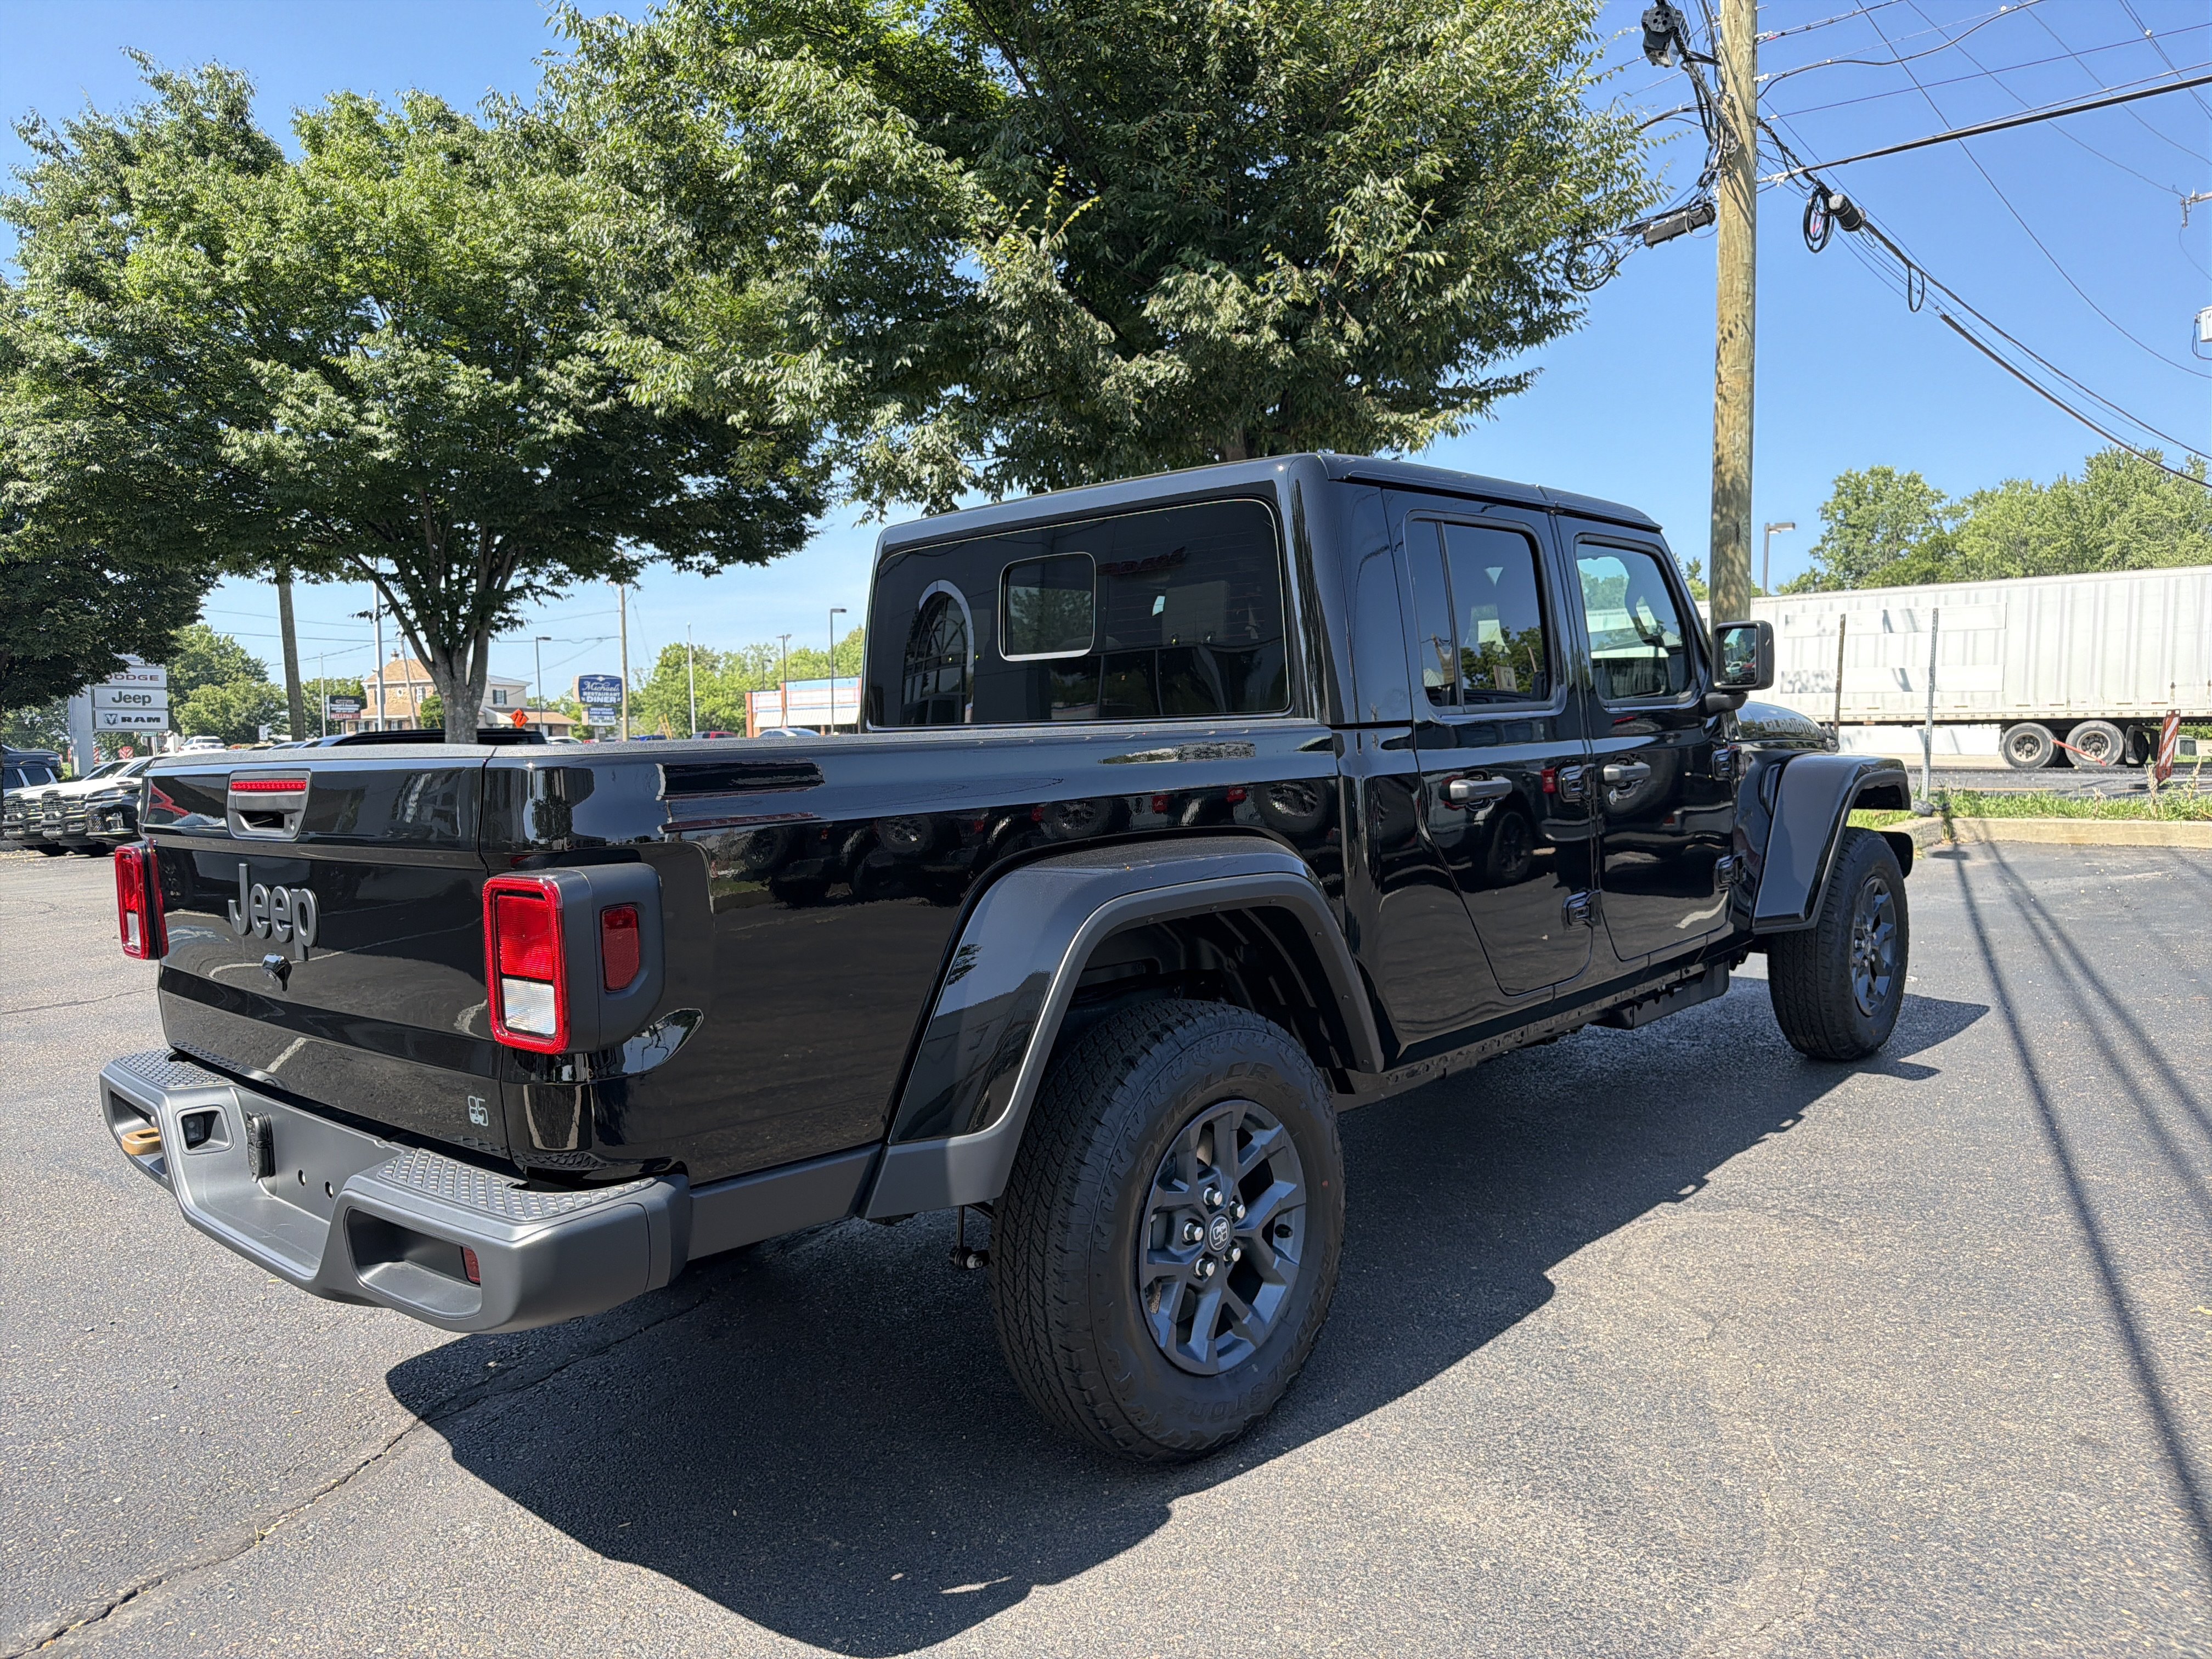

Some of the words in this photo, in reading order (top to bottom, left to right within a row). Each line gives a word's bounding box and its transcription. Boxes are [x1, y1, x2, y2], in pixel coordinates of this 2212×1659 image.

[111, 691, 152, 706] Jeep
[228, 863, 320, 961] Jeep
[467, 1096, 488, 1127] 85
